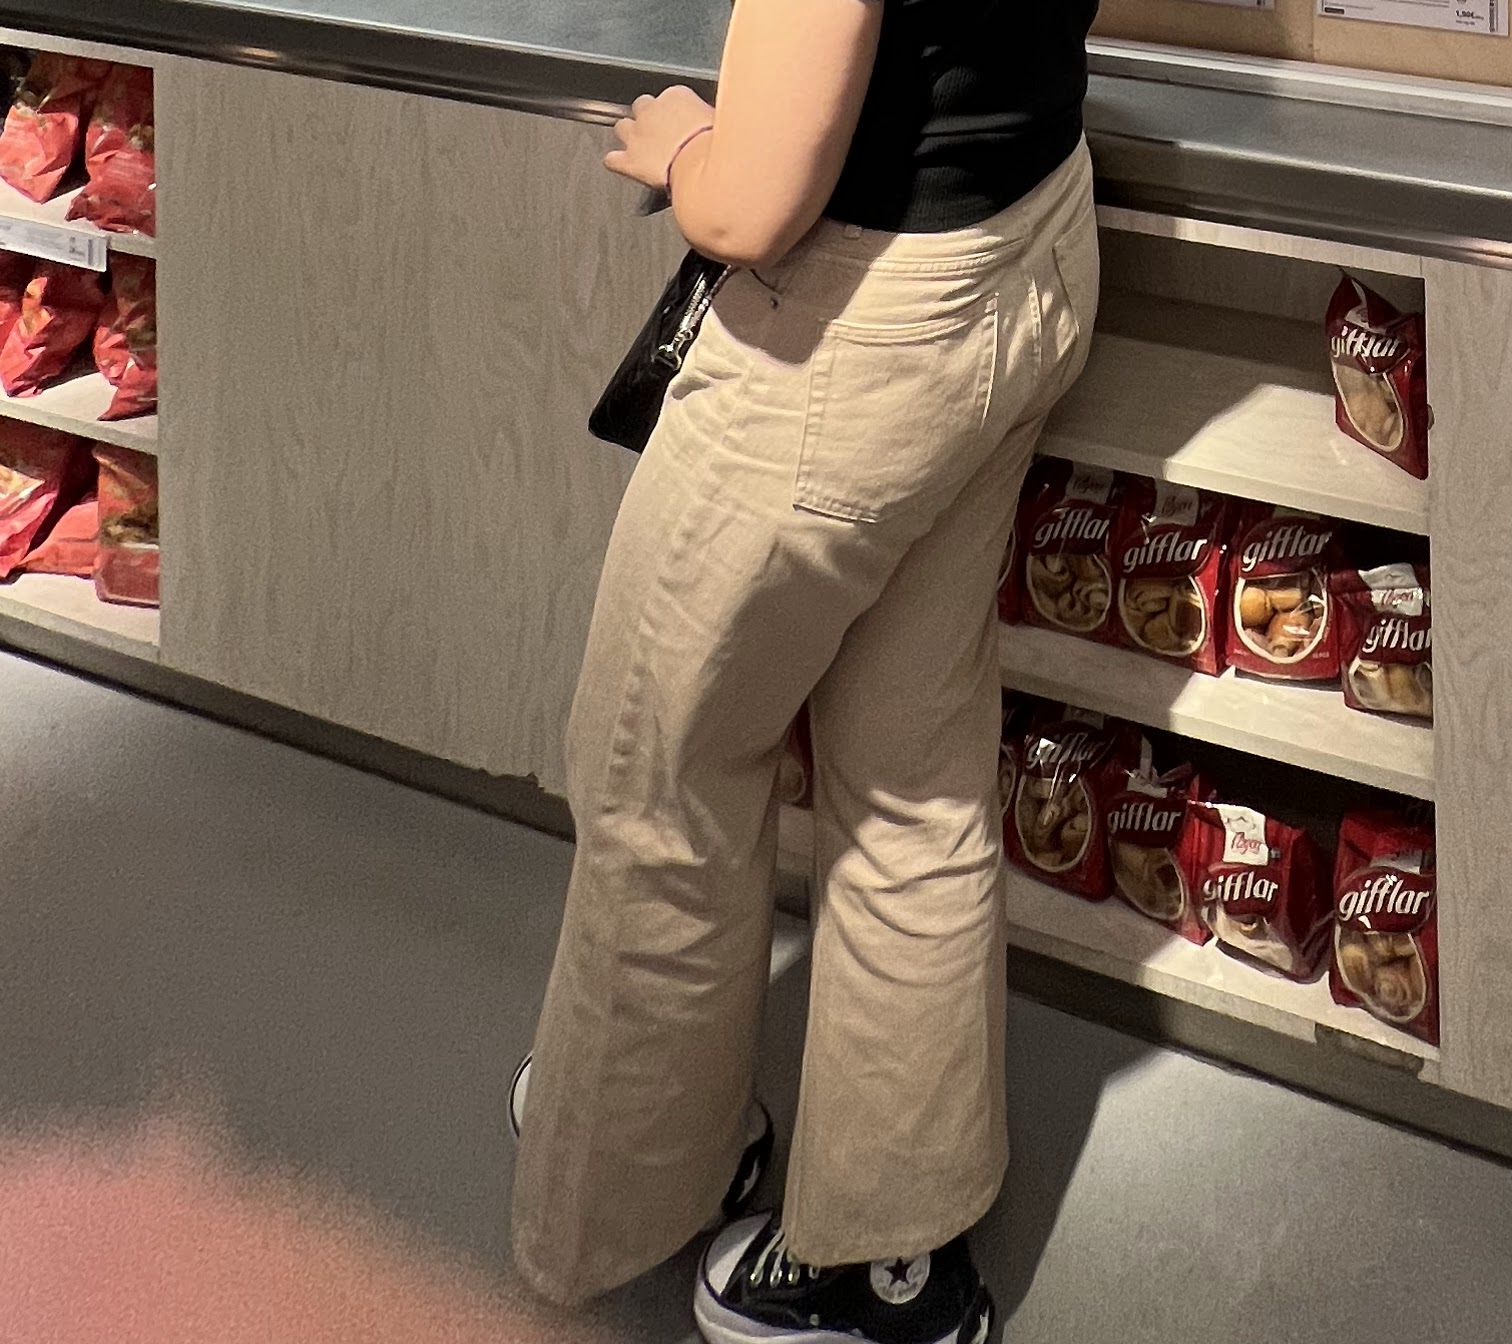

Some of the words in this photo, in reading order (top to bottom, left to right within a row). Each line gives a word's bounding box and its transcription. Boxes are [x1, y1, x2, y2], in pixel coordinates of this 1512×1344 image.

[1123, 531, 1208, 573] gifflar
[1241, 525, 1333, 572] gifflar
[1107, 800, 1182, 834] gifflar
[1203, 871, 1279, 902] gifflar
[1338, 874, 1430, 922] gifflar
